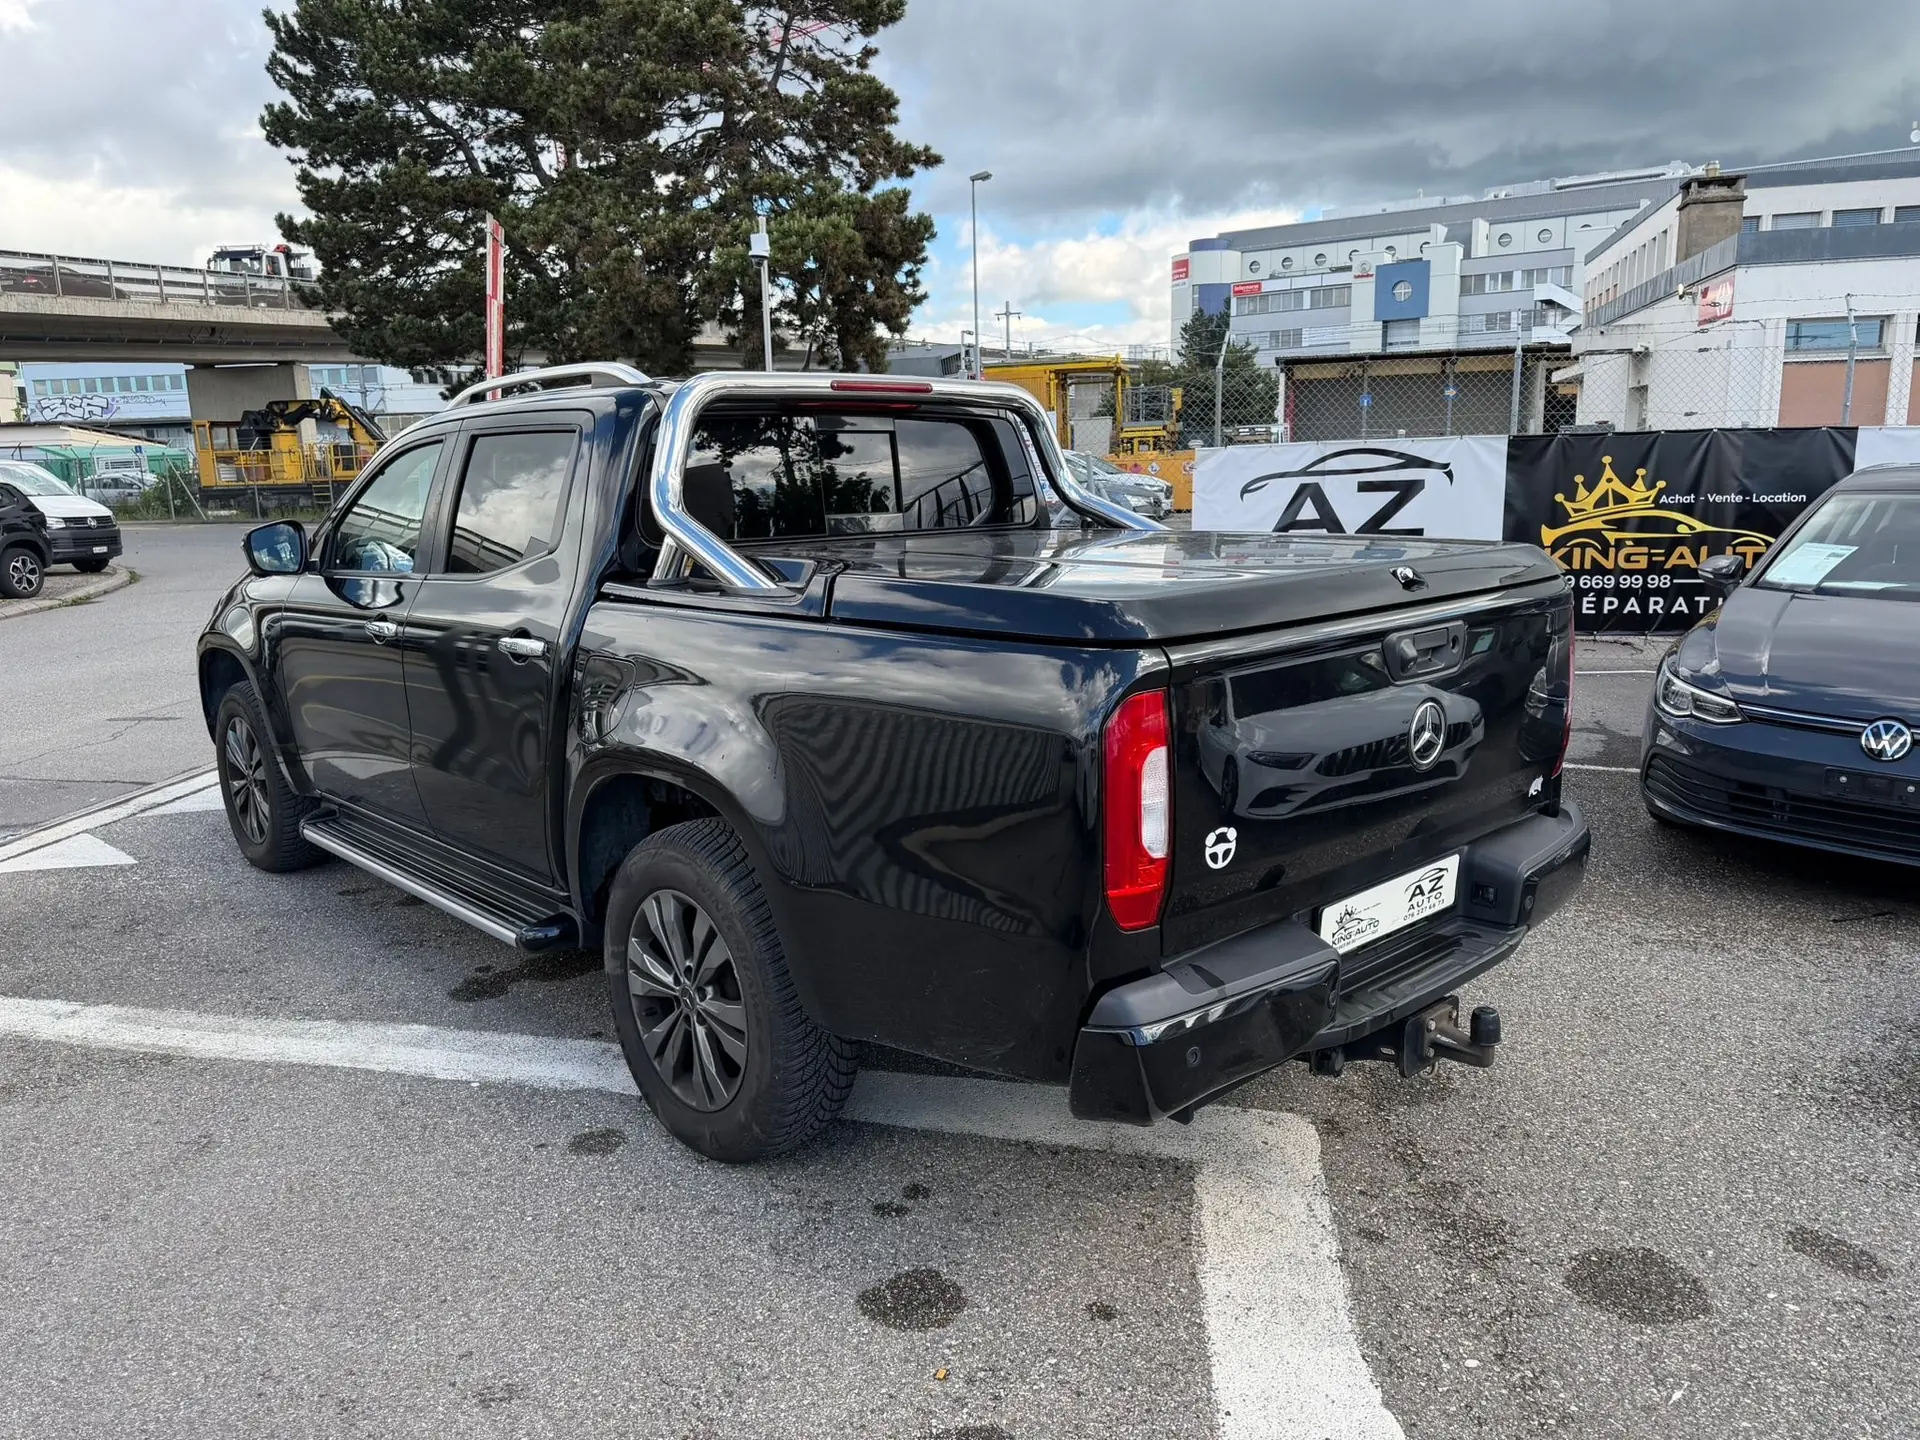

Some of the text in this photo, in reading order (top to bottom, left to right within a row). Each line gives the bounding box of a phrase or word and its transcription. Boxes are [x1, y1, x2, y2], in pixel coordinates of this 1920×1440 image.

[1272, 479, 1426, 537] AZ
[1659, 493, 1696, 504] Achat
[1707, 493, 1743, 503] Vente
[1752, 492, 1807, 503] Location
[1564, 574, 1671, 589] 9 669 99 98
[1581, 592, 1724, 614] ÉPARATI
[1408, 874, 1445, 903] AZ
[1408, 891, 1442, 912] AUTO
